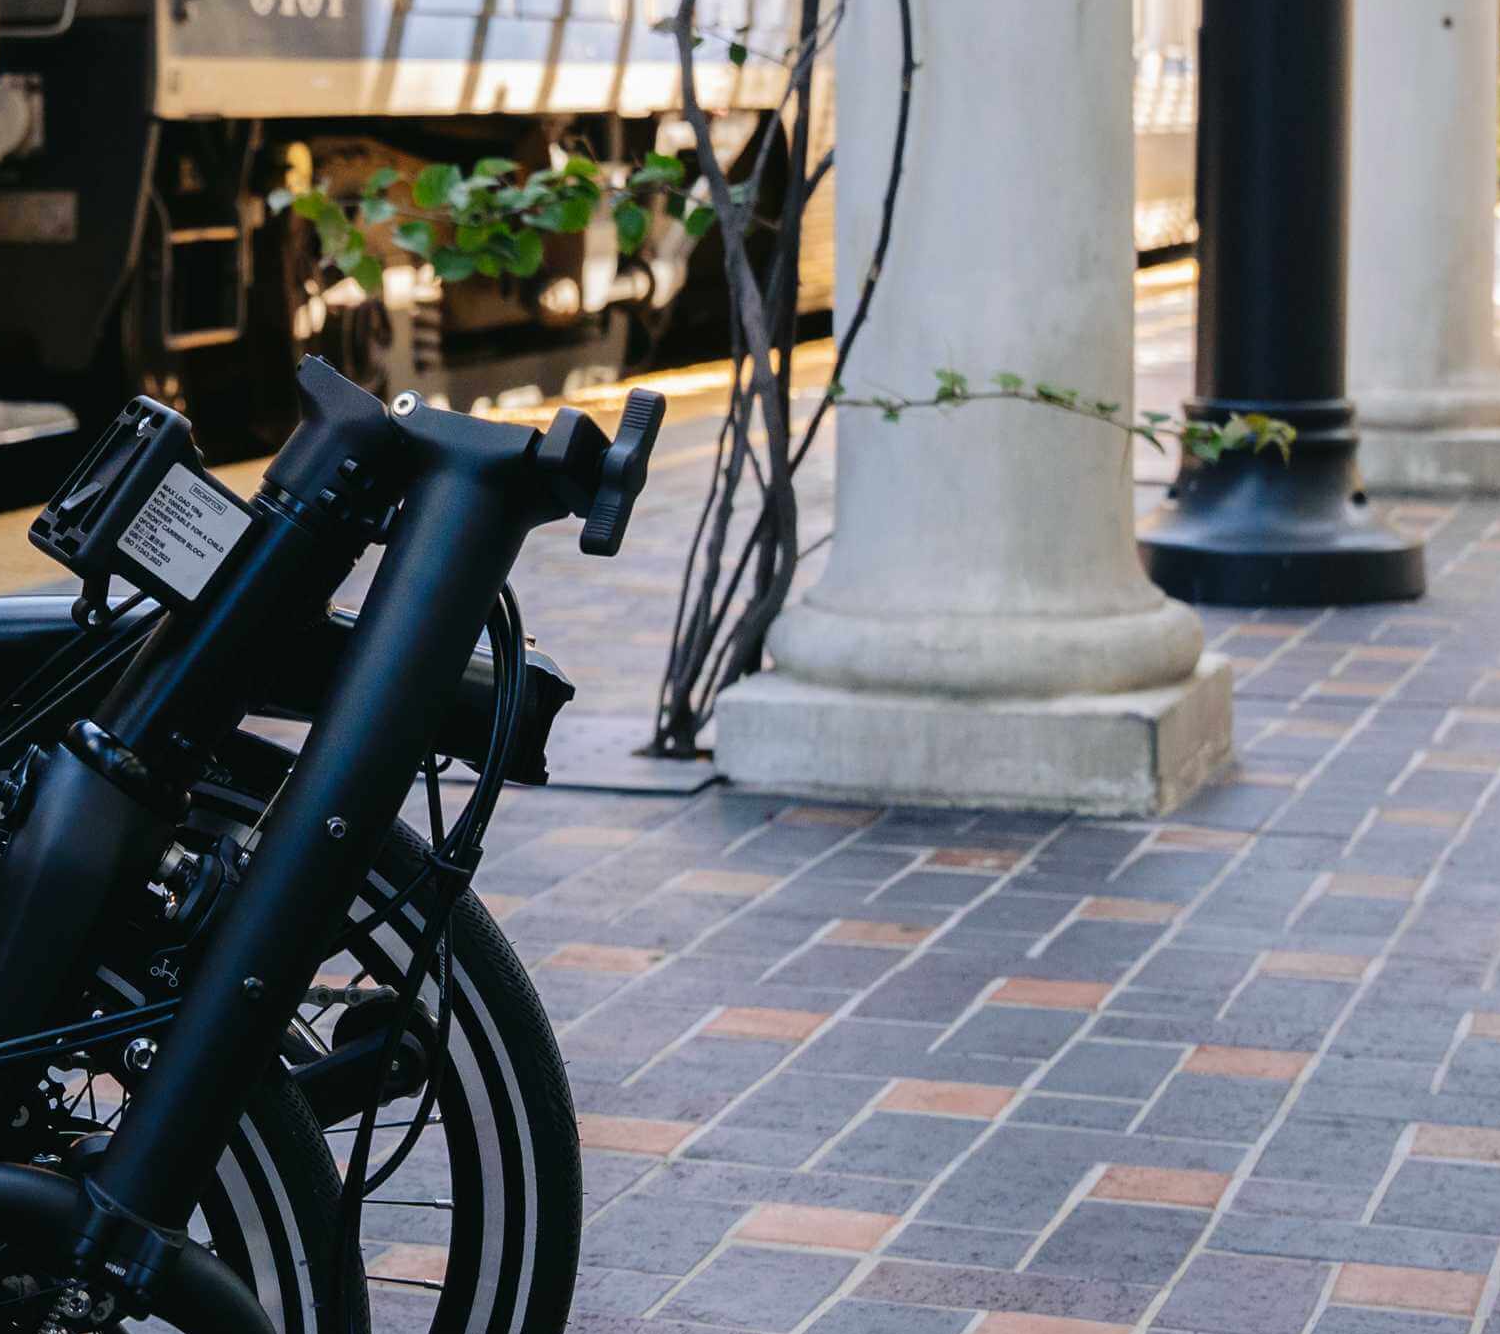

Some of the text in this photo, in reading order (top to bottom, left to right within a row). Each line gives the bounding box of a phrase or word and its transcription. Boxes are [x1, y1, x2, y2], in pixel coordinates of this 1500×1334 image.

[162, 484, 176, 496] MAX
[174, 494, 191, 508] LOAD
[192, 486, 224, 512] BROMPTON
[147, 503, 172, 524] CARRIER
[152, 497, 165, 509] NOT
[164, 506, 190, 528] SUITABLE
[190, 526, 203, 538] FOR
[206, 538, 224, 553] CHILD
[143, 510, 205, 559] FRONT CARRIER BLOCK
